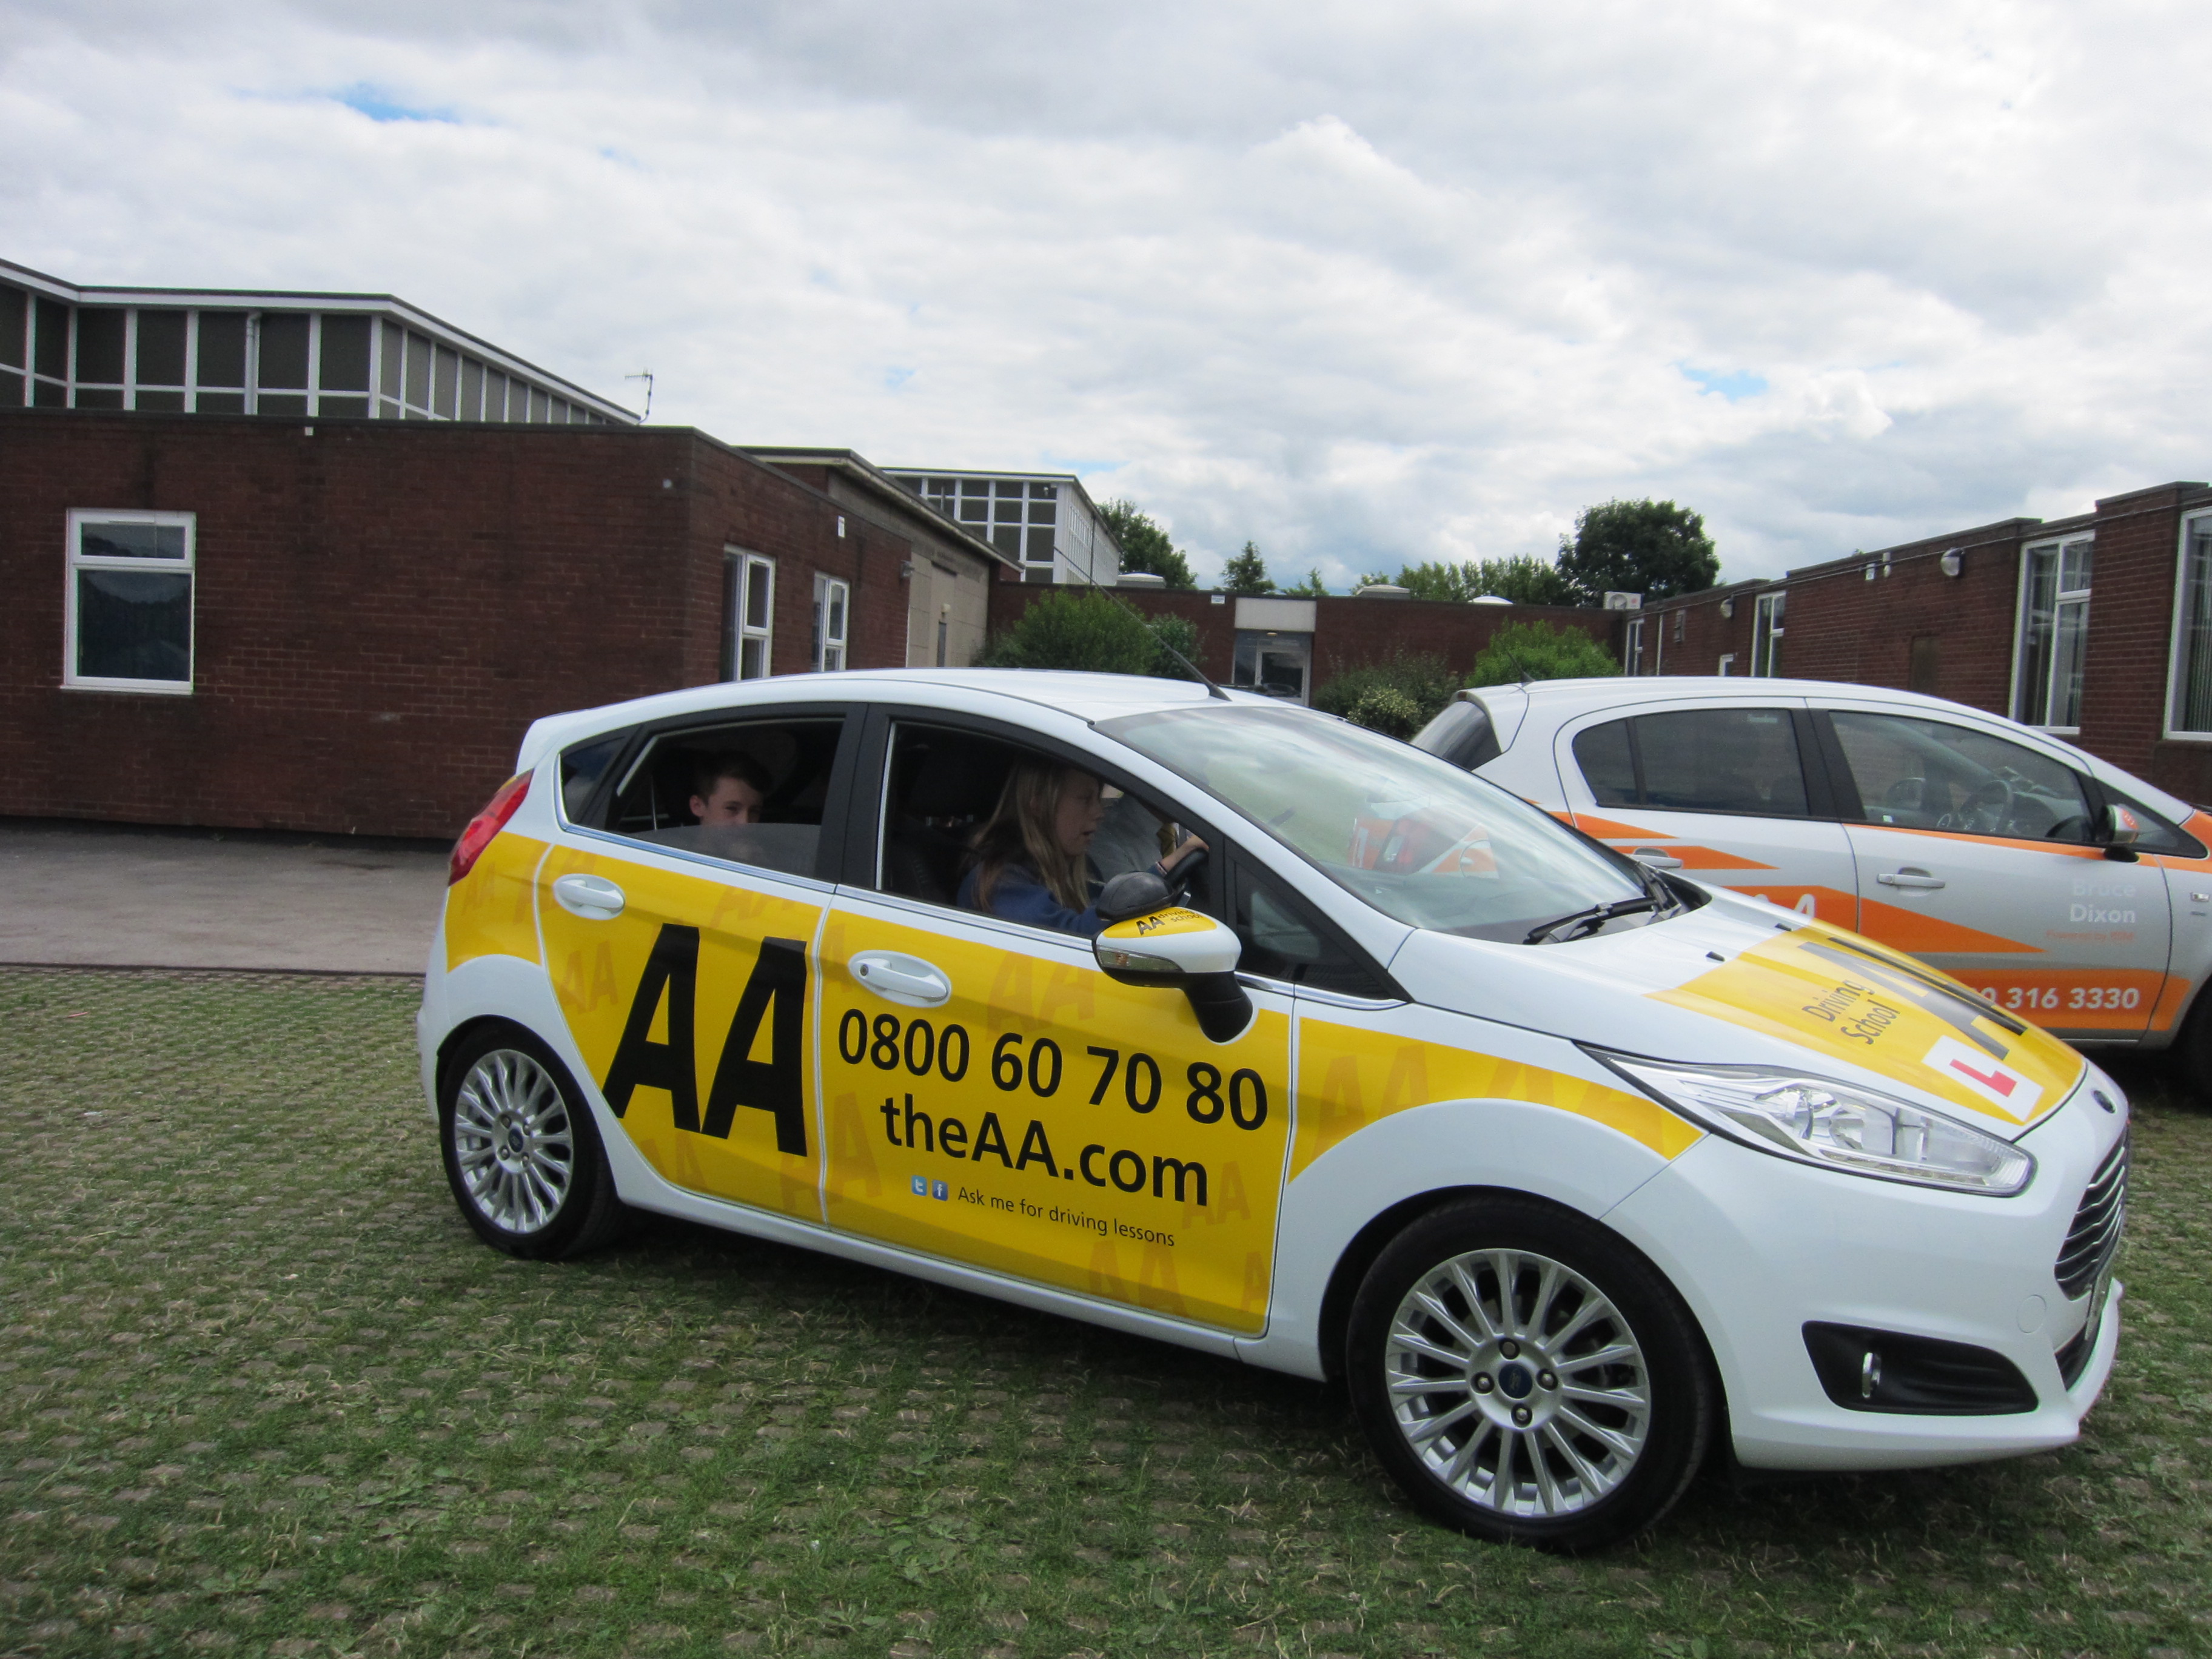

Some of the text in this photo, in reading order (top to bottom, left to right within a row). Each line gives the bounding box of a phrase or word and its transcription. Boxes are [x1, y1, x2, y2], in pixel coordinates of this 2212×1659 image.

[2071, 877, 2136, 897] Bruce
[1136, 916, 1165, 936] AA
[1170, 913, 1204, 922] school
[2070, 903, 2136, 923] Dixon
[1801, 980, 1875, 1022] Driving
[2005, 987, 2059, 1009] 316
[2068, 987, 2140, 1009] 3330
[602, 922, 808, 1157] AA
[1840, 999, 1900, 1045] School
[839, 1008, 1268, 1131] 0800 60 70 80
[1949, 1059, 2017, 1097] L
[880, 1093, 1207, 1206] theAA.com
[958, 1187, 985, 1205] Ask
[991, 1196, 1014, 1212] me
[1019, 1198, 1044, 1218] for
[1049, 1206, 1107, 1236] driving
[1114, 1218, 1175, 1247] lessons
